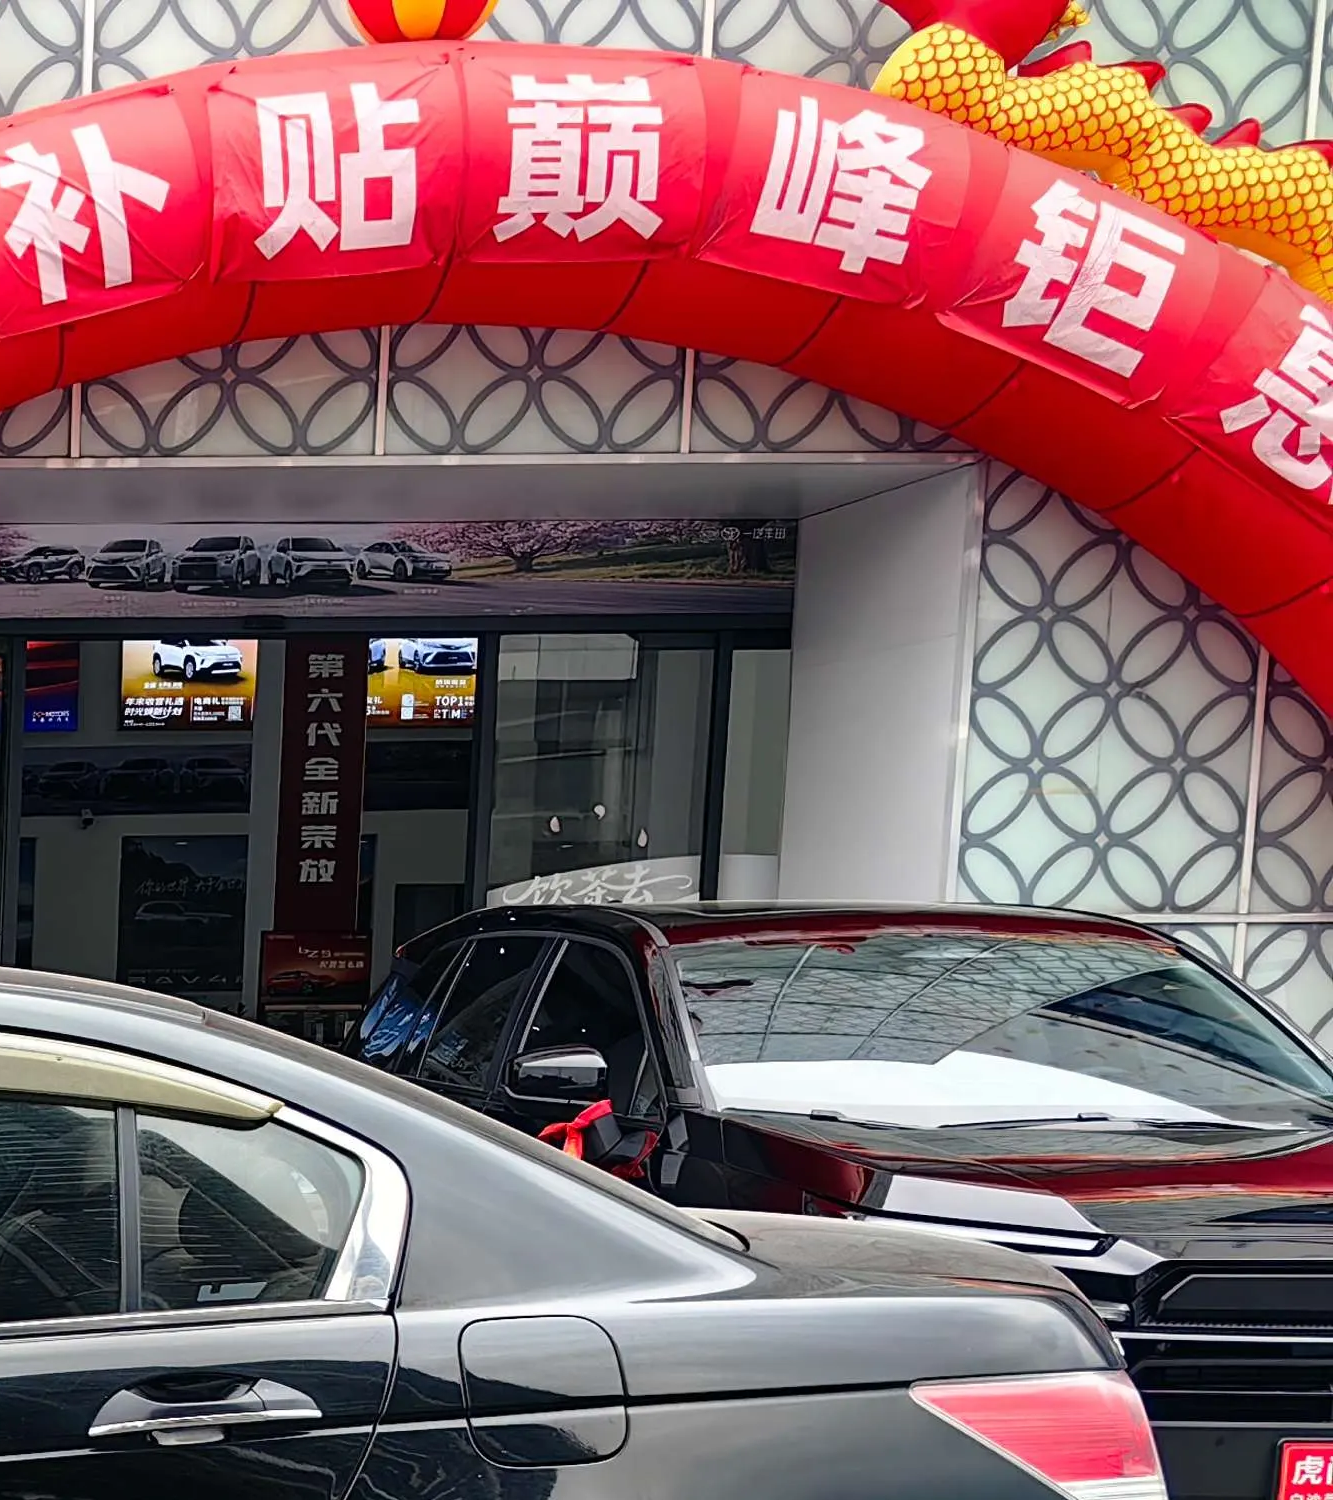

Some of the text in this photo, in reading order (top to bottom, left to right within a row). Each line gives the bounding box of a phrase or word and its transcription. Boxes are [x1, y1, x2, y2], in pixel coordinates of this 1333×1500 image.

[299, 653, 345, 883] 第六代全新荣放
